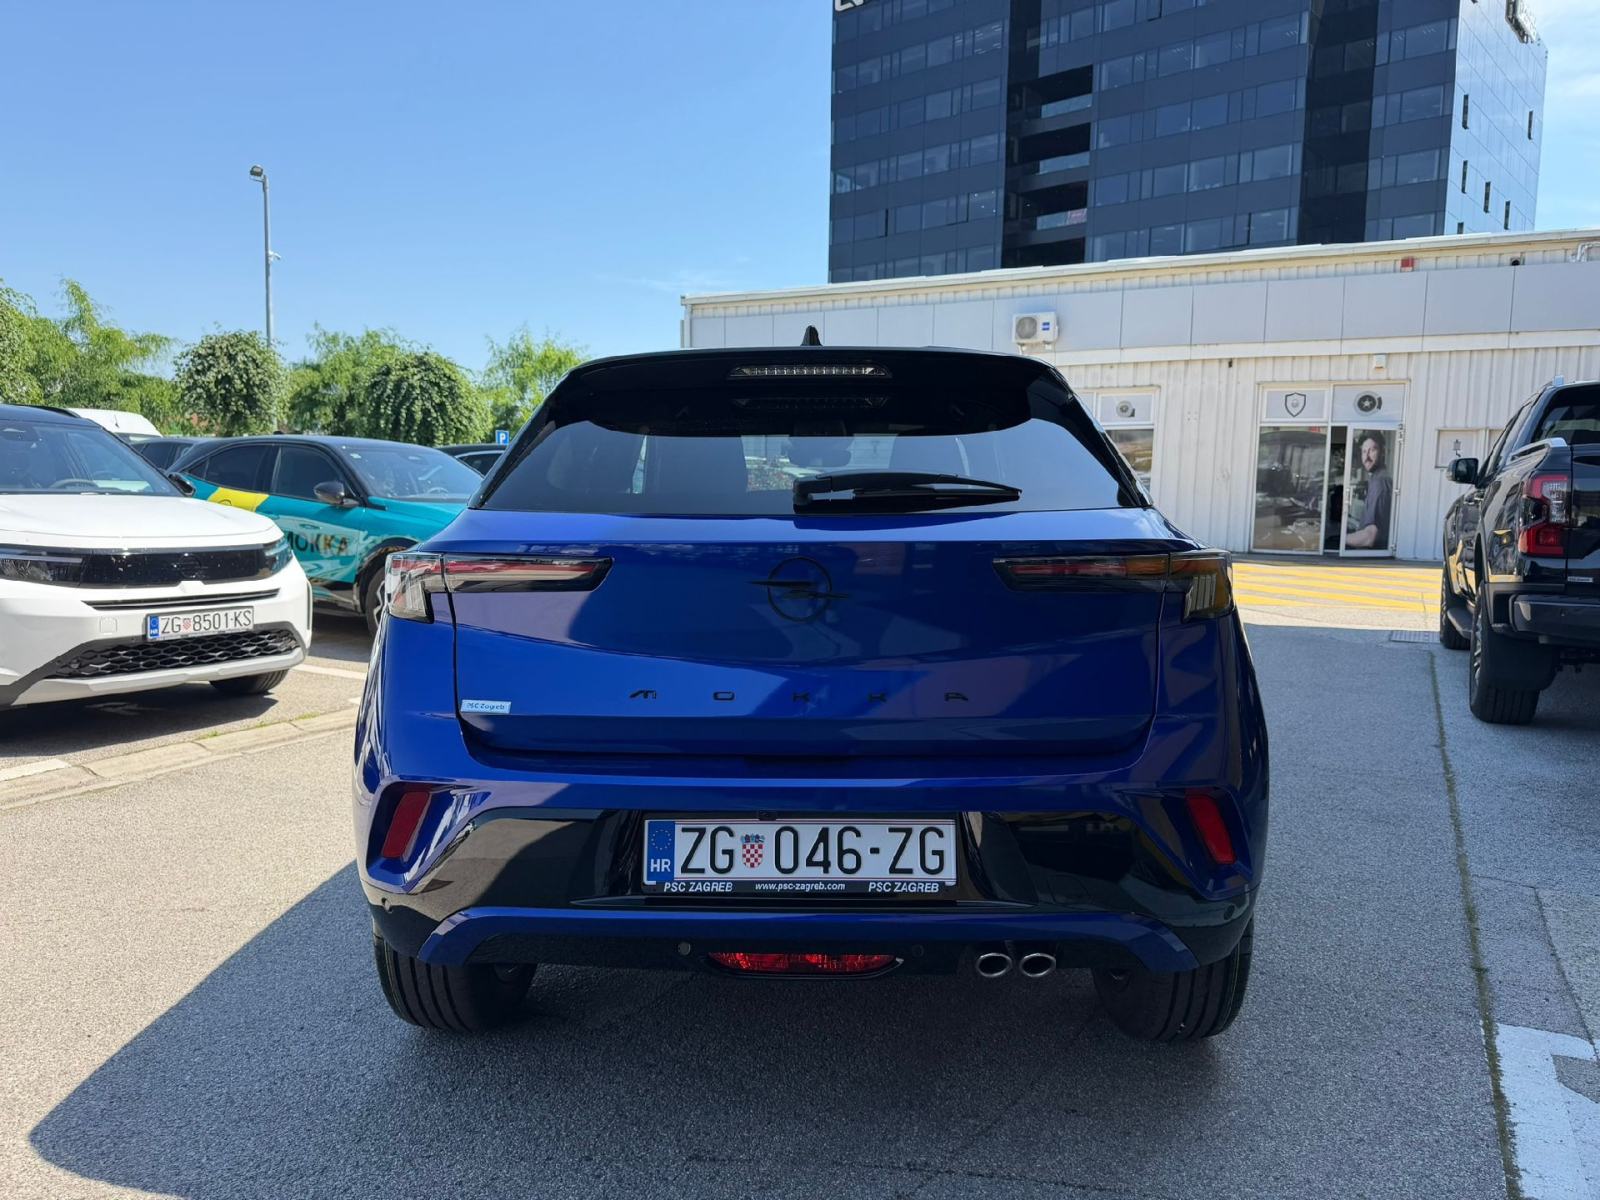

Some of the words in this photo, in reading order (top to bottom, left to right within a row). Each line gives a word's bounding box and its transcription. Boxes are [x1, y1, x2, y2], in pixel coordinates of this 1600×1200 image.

[161, 616, 181, 634] ZG
[629, 690, 969, 702] MOKKA
[680, 825, 735, 875] ZG
[774, 825, 945, 875] 046-ZG
[650, 858, 671, 873] HR
[663, 882, 686, 892] PSC
[688, 882, 733, 892] ZAGREB
[755, 882, 846, 892] www.psc-zagreb.com
[868, 882, 892, 892] PSC
[893, 882, 940, 892] ZAGREB
